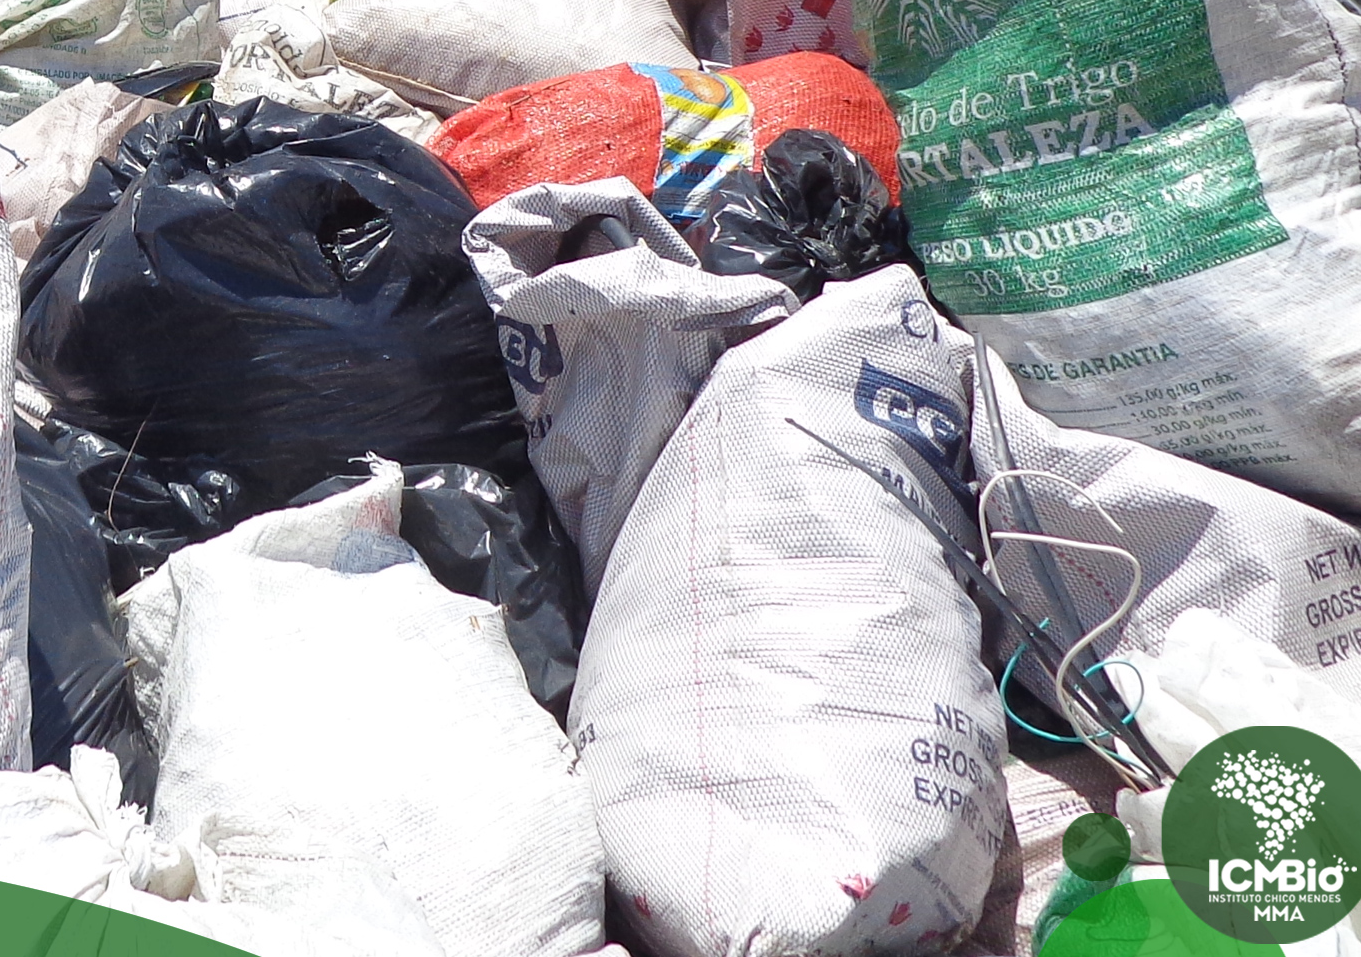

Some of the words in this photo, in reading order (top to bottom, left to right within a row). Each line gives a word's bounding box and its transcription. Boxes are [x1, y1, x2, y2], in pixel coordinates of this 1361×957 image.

[949, 85, 995, 127] de
[1007, 58, 1139, 106] Trigo
[896, 101, 1158, 192] RTALEZA
[1014, 263, 1069, 299] kg
[1031, 362, 1060, 382] DE
[1303, 548, 1338, 584] NET
[933, 703, 974, 736] NET
